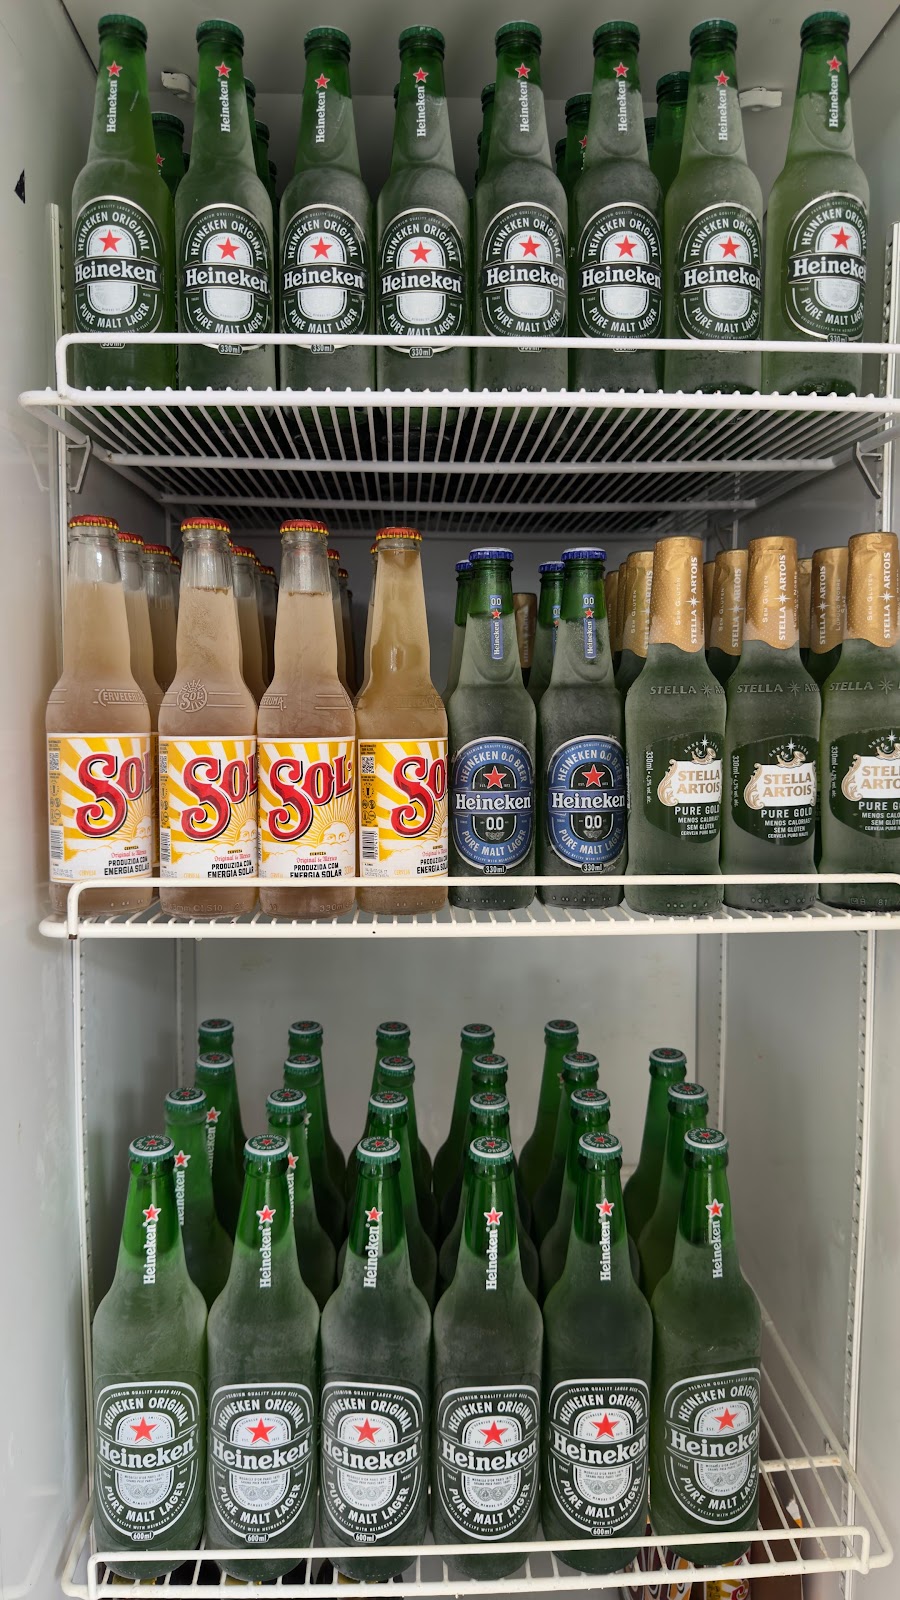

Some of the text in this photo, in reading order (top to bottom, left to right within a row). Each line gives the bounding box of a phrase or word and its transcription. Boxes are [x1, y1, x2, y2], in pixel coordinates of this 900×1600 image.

[107, 80, 118, 132] Heineken
[221, 80, 231, 132] Heineken
[417, 86, 426, 138] Heineken
[520, 82, 530, 132] Heineken
[618, 80, 627, 132] Heineken
[719, 89, 728, 141] Heineken
[829, 75, 839, 127] Heineken
[316, 92, 325, 143] Heineken
[78, 212, 150, 251] HEINEKEN ORIGINAL
[191, 220, 227, 255] HEINEKEN
[232, 221, 264, 261] ORIGINAL
[288, 220, 320, 258] HEINEKEN
[324, 220, 358, 257] ORIGINAL
[386, 224, 456, 263] HEINEKEN ORIGINAL
[492, 218, 529, 255] HEINEKEN
[534, 219, 562, 258] ORIGINAL
[588, 218, 625, 256] HEINEKEN
[629, 219, 658, 257] ORIGINAL
[691, 219, 729, 256] HEINEKEN
[733, 219, 758, 258] ORIGINAL
[801, 209, 842, 246] HEINEKEN
[75, 261, 156, 283] Heineken
[186, 267, 268, 293] Heineken
[284, 267, 365, 290] Heineken
[382, 271, 461, 294] Heineken
[487, 265, 565, 290] Heineken
[582, 266, 661, 289] Heineken
[684, 267, 760, 290] Heineken
[80, 302, 150, 328] PURE MALT LAGER
[289, 309, 357, 333] PURE MALT LAGER
[494, 307, 540, 332] PURE MALT
[589, 307, 657, 332] PURE MALT LAGER
[692, 309, 738, 333] PURE MALT
[460, 751, 526, 782] HEINEKEN 0.0 BEER
[558, 750, 622, 781] HEINEKEN 0.0 BEER
[678, 769, 720, 781] STELLA
[764, 772, 812, 785] STELLA
[269, 756, 351, 842] SOL
[391, 755, 448, 839] SO
[456, 793, 531, 810] Heineken
[552, 792, 625, 808] Heineken
[677, 782, 720, 794] ARTOIS
[763, 784, 812, 797] ARTOIS
[584, 815, 602, 829] 0.0
[675, 806, 701, 815] PURE
[761, 807, 812, 818] PURE GOLD
[859, 802, 887, 810] PURE
[486, 817, 503, 830] 0.0
[462, 829, 526, 856] PURE MALT LAGER
[559, 829, 575, 850] PURE
[580, 845, 602, 855] MALT
[606, 828, 621, 850] LAGER
[104, 866, 133, 876] ENERGIA
[322, 869, 342, 877] SOLAR
[583, 864, 602, 872] 330ml
[144, 1224, 157, 1284] Heineken
[260, 1227, 271, 1288] Heineken
[364, 1226, 379, 1288] Heineken
[486, 1229, 497, 1290] Heineken
[600, 1221, 611, 1281] Heineken
[713, 1221, 722, 1279] Heineken
[104, 1397, 189, 1430] HEINEKEN ORIGINAL
[218, 1399, 305, 1431] HEINEKEN ORIGINAL
[327, 1399, 412, 1433] HEINEKEN ORIGINAL
[448, 1401, 533, 1433] HEINEKEN ORIGINAL
[560, 1395, 644, 1425] HEINEKEN ORIGINAL
[679, 1388, 725, 1422] HEINEKEN
[100, 1437, 194, 1469] Heineken
[213, 1439, 309, 1470] Heineken
[324, 1433, 418, 1470] Heineken
[442, 1440, 536, 1472] Heineken
[554, 1430, 646, 1464] Heineken
[105, 1485, 123, 1514] PURE
[126, 1511, 155, 1522] MALT
[159, 1481, 186, 1516] LAGER
[219, 1487, 237, 1516] PURE
[240, 1512, 270, 1525] MALT
[275, 1484, 301, 1518] LAGER
[328, 1481, 345, 1513] PURE
[348, 1511, 376, 1525] MALT
[382, 1487, 409, 1520] LAGER
[449, 1487, 469, 1517] PURE
[473, 1513, 503, 1525] MALT
[508, 1483, 530, 1517] LAGER
[561, 1480, 582, 1510] PURE
[585, 1506, 615, 1518] MALT
[619, 1477, 641, 1512] LAGER
[681, 1477, 706, 1504] PURE
[708, 1498, 737, 1510] MALT
[593, 1527, 612, 1535] 600ml
